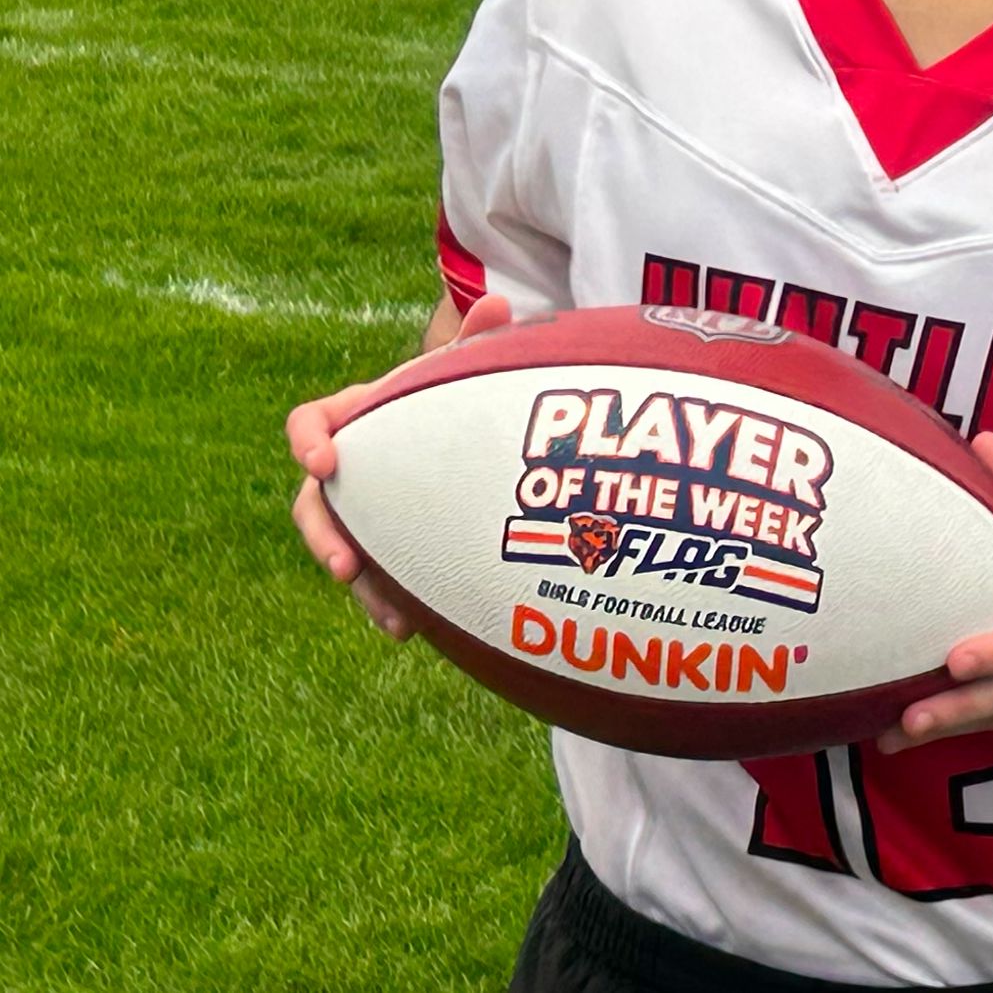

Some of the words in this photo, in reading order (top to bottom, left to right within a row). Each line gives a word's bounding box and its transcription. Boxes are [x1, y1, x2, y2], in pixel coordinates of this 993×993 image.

[524, 390, 832, 508] PLAYER
[517, 466, 587, 509] OF
[593, 469, 681, 520] THE
[689, 483, 819, 557] WEEK
[603, 528, 749, 589] FLAG
[511, 603, 808, 694] DUNKIN'
[591, 593, 688, 627] FOOTBALL
[691, 610, 768, 635] LEAGUE
